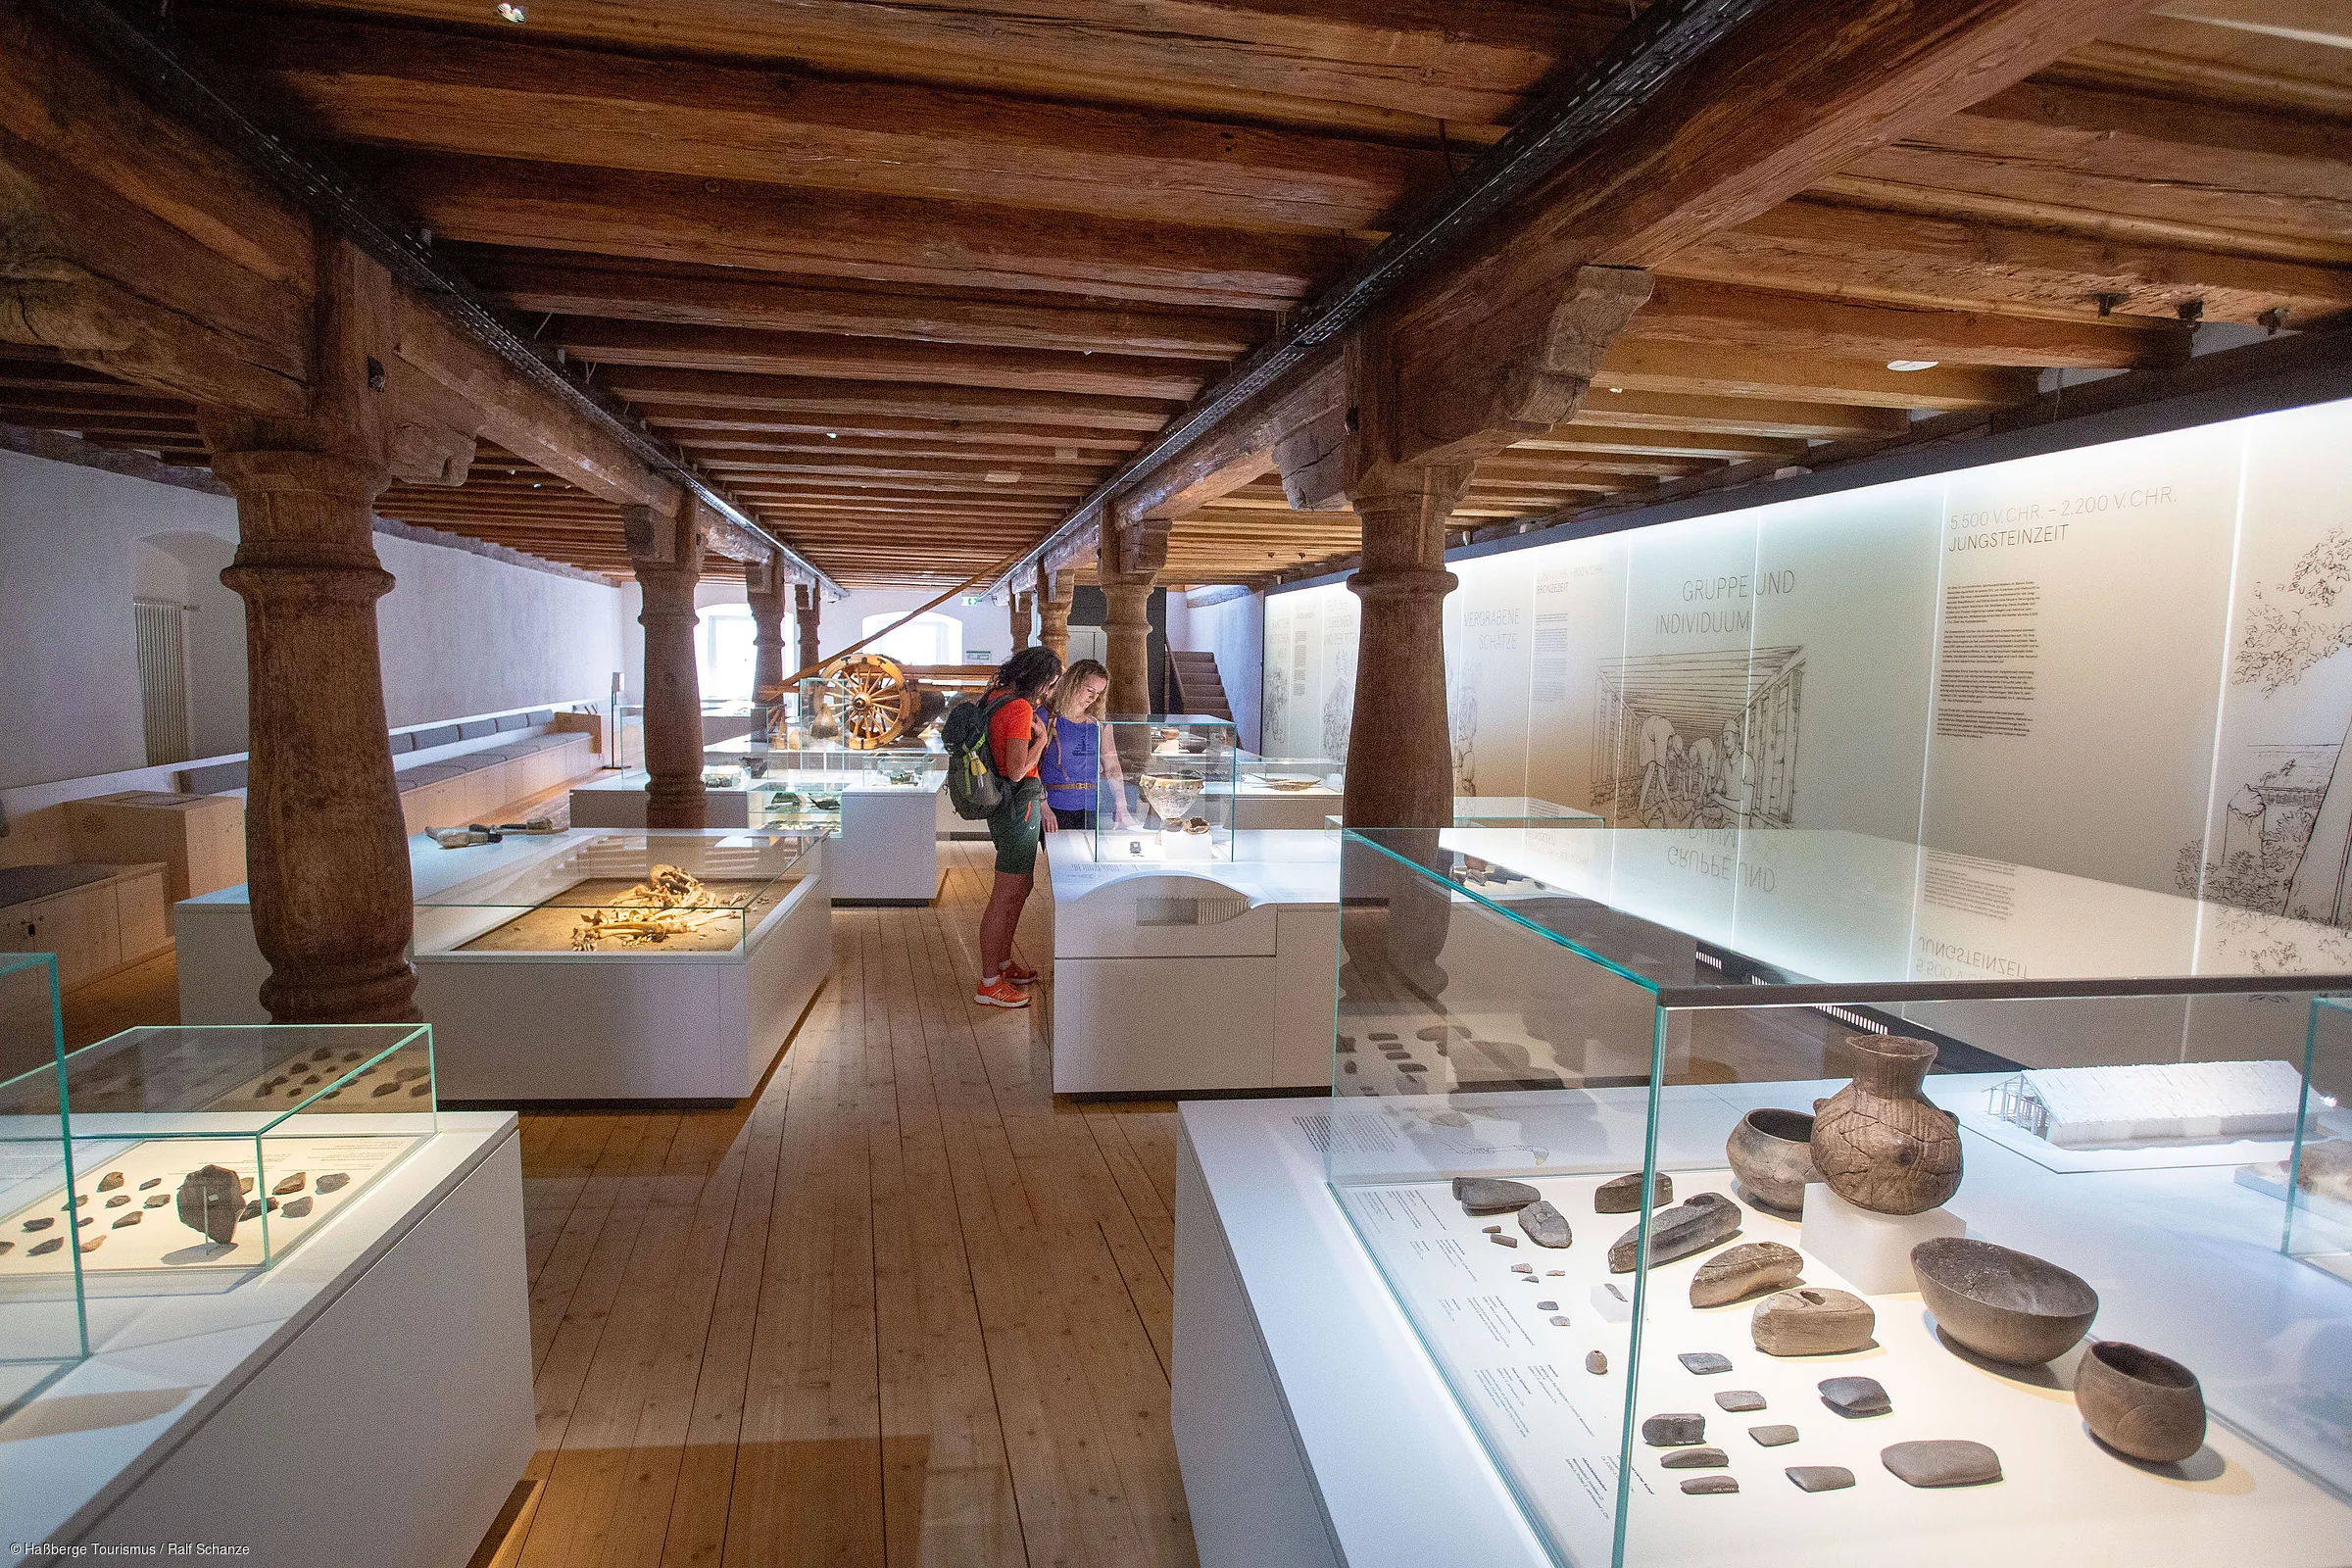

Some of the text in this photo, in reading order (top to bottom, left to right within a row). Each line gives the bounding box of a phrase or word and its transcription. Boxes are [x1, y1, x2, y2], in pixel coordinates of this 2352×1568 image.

[1949, 510, 1989, 530] 5.500
[2061, 494, 2108, 516] 2.200
[1948, 523, 2070, 552] JUNGSTEINZEIT
[1682, 569, 1795, 601] GRUPPE UND
[1463, 608, 1520, 627] VERGRABENE
[1655, 611, 1751, 634] INDIVIDUUM
